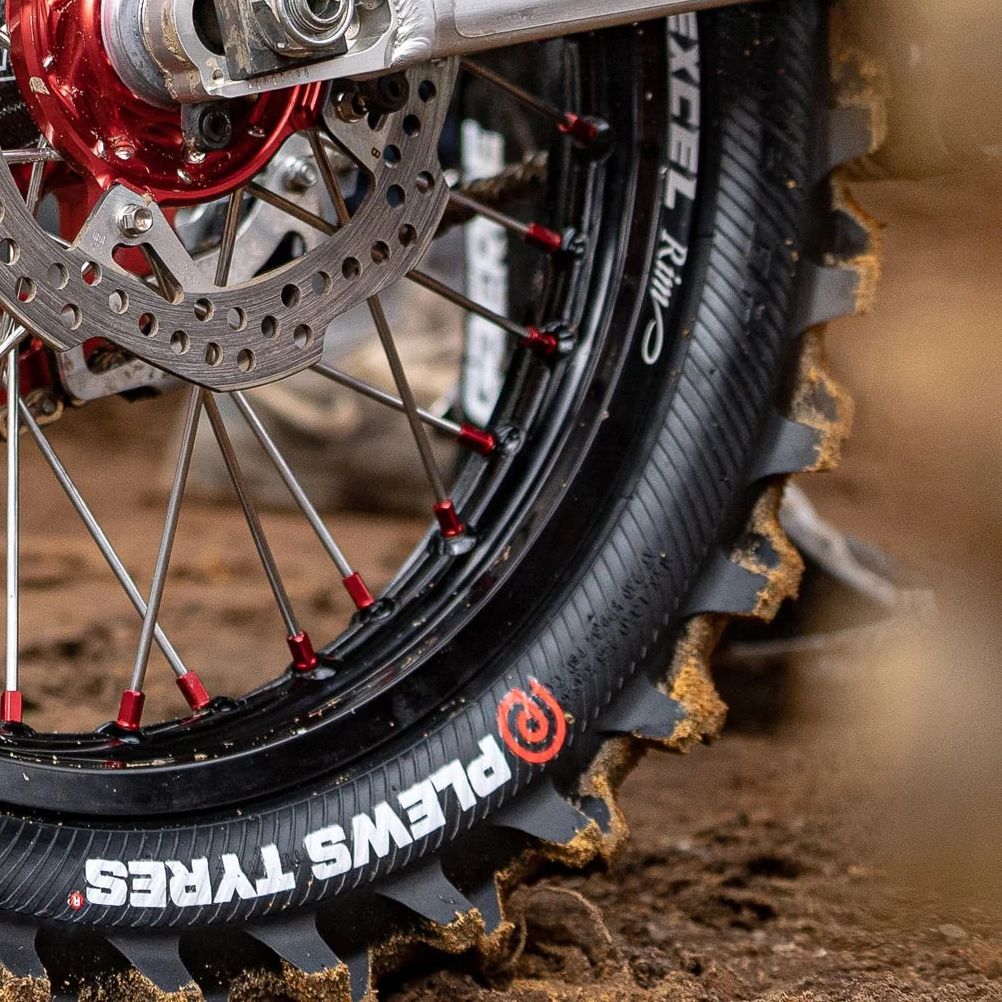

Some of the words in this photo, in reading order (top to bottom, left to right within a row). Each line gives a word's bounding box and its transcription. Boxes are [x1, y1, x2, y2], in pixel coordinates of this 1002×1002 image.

[641, 228, 689, 366] Rim
[85, 843, 297, 909] TYRES
[304, 733, 513, 881] PLEWS
